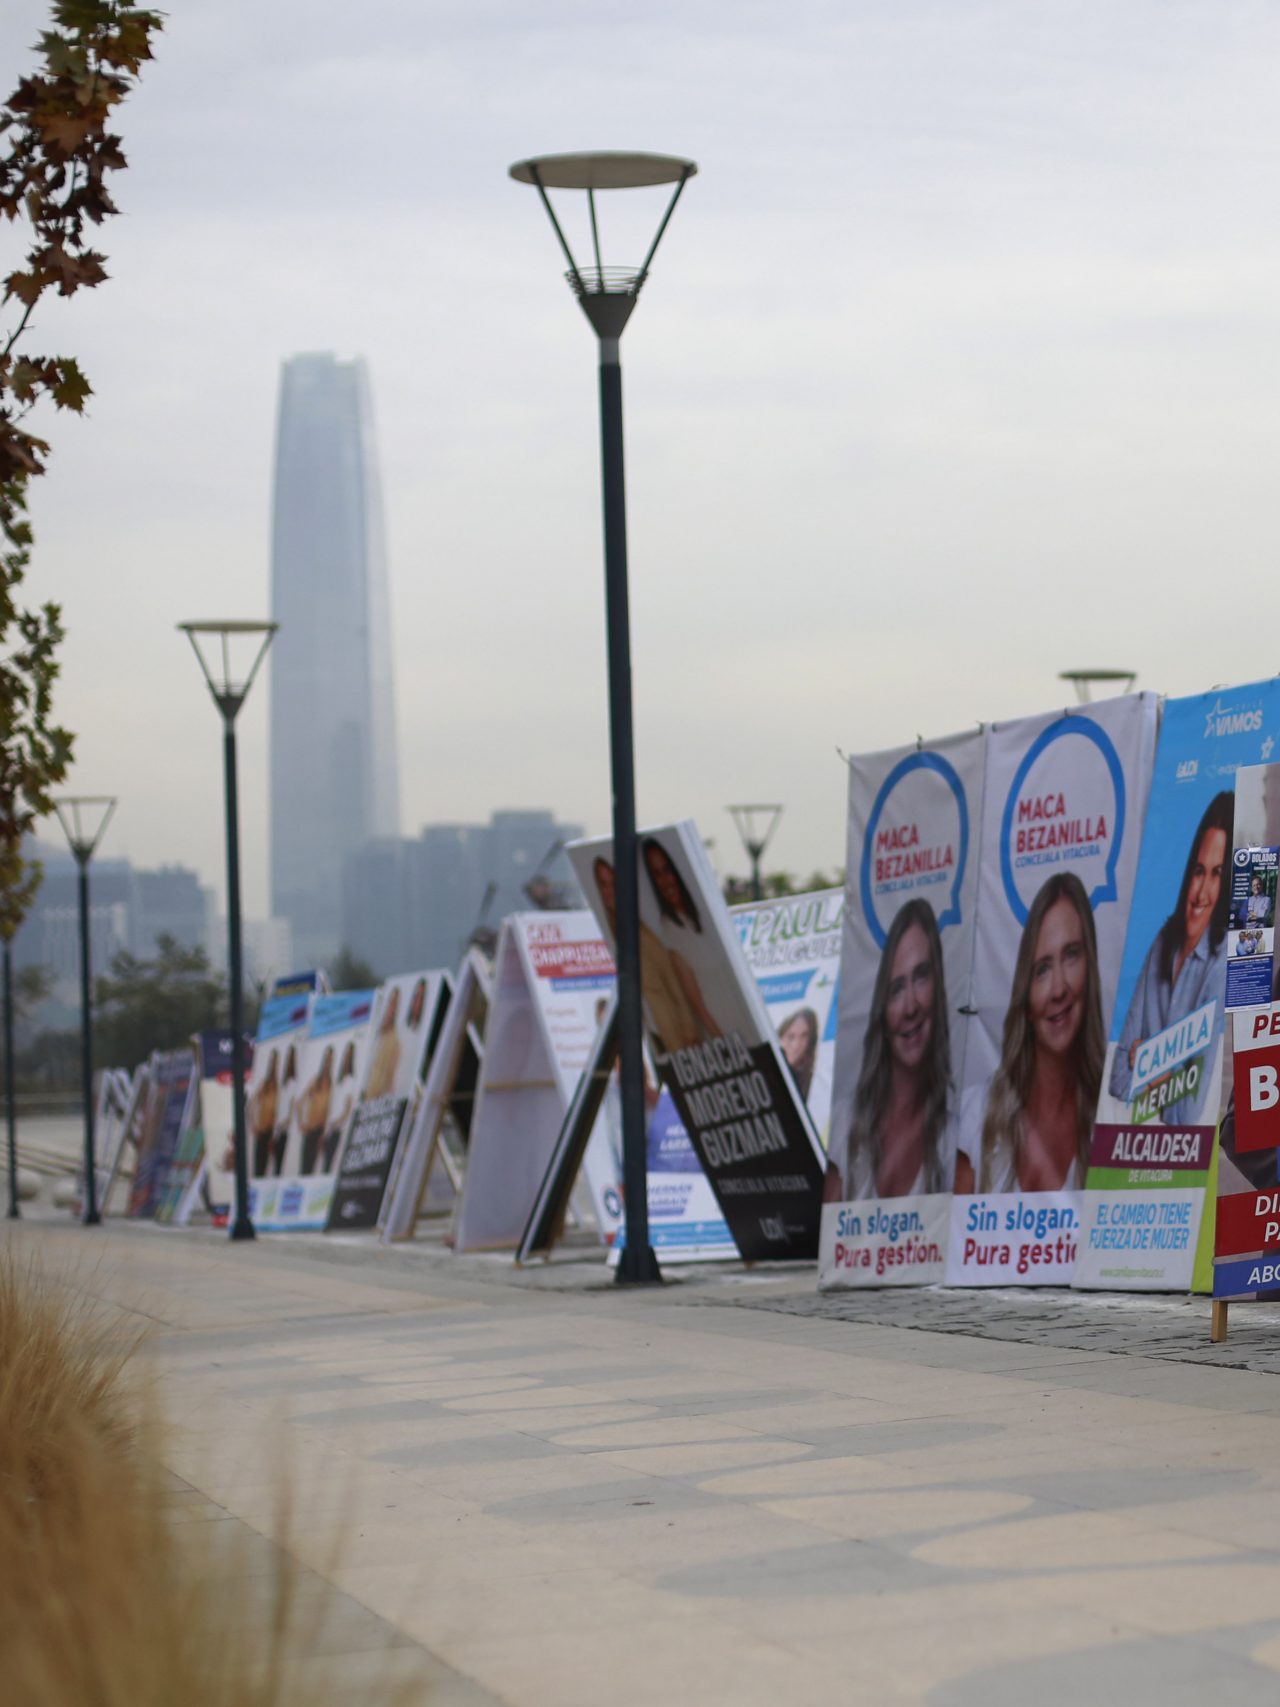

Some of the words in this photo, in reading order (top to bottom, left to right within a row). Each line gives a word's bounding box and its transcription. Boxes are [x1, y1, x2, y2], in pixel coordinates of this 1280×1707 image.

[1216, 709, 1263, 736] VAMOS
[1018, 792, 1065, 823] MACA
[876, 823, 919, 853] MACA
[1016, 815, 1107, 853] BEZANILLA
[876, 844, 953, 882] BEZANILLA
[1015, 850, 1060, 868] CONCEJALA
[1063, 844, 1101, 860] VITACURA
[1251, 853, 1277, 863] BOLADOS
[876, 879, 914, 895] CONCEJALA
[916, 871, 947, 887] VITACURA
[671, 1033, 754, 1088] IGNACIA
[1137, 1012, 1208, 1079] CAMILA
[684, 1071, 773, 1129] MORENO
[1135, 1065, 1198, 1121] MERINO
[700, 1108, 788, 1167] GUZMÁN
[1111, 1133, 1201, 1162] ALCALDESA
[1128, 1170, 1139, 1183] DE
[1139, 1169, 1173, 1183] VITACURA
[836, 1209, 861, 1236] Sin
[867, 1207, 924, 1242] slogan.
[966, 1202, 998, 1232] Sin
[1005, 1202, 1080, 1239] slogan.
[1097, 1204, 1110, 1225] EL
[1111, 1203, 1157, 1225] CAMBIO
[1158, 1202, 1192, 1225] TIENE
[963, 1238, 1009, 1265] Pura
[1088, 1227, 1132, 1249] FUERZA
[1134, 1228, 1149, 1249] DE
[1150, 1228, 1190, 1249] MUJER
[835, 1243, 871, 1268] Pura
[876, 1235, 943, 1275] gestión.
